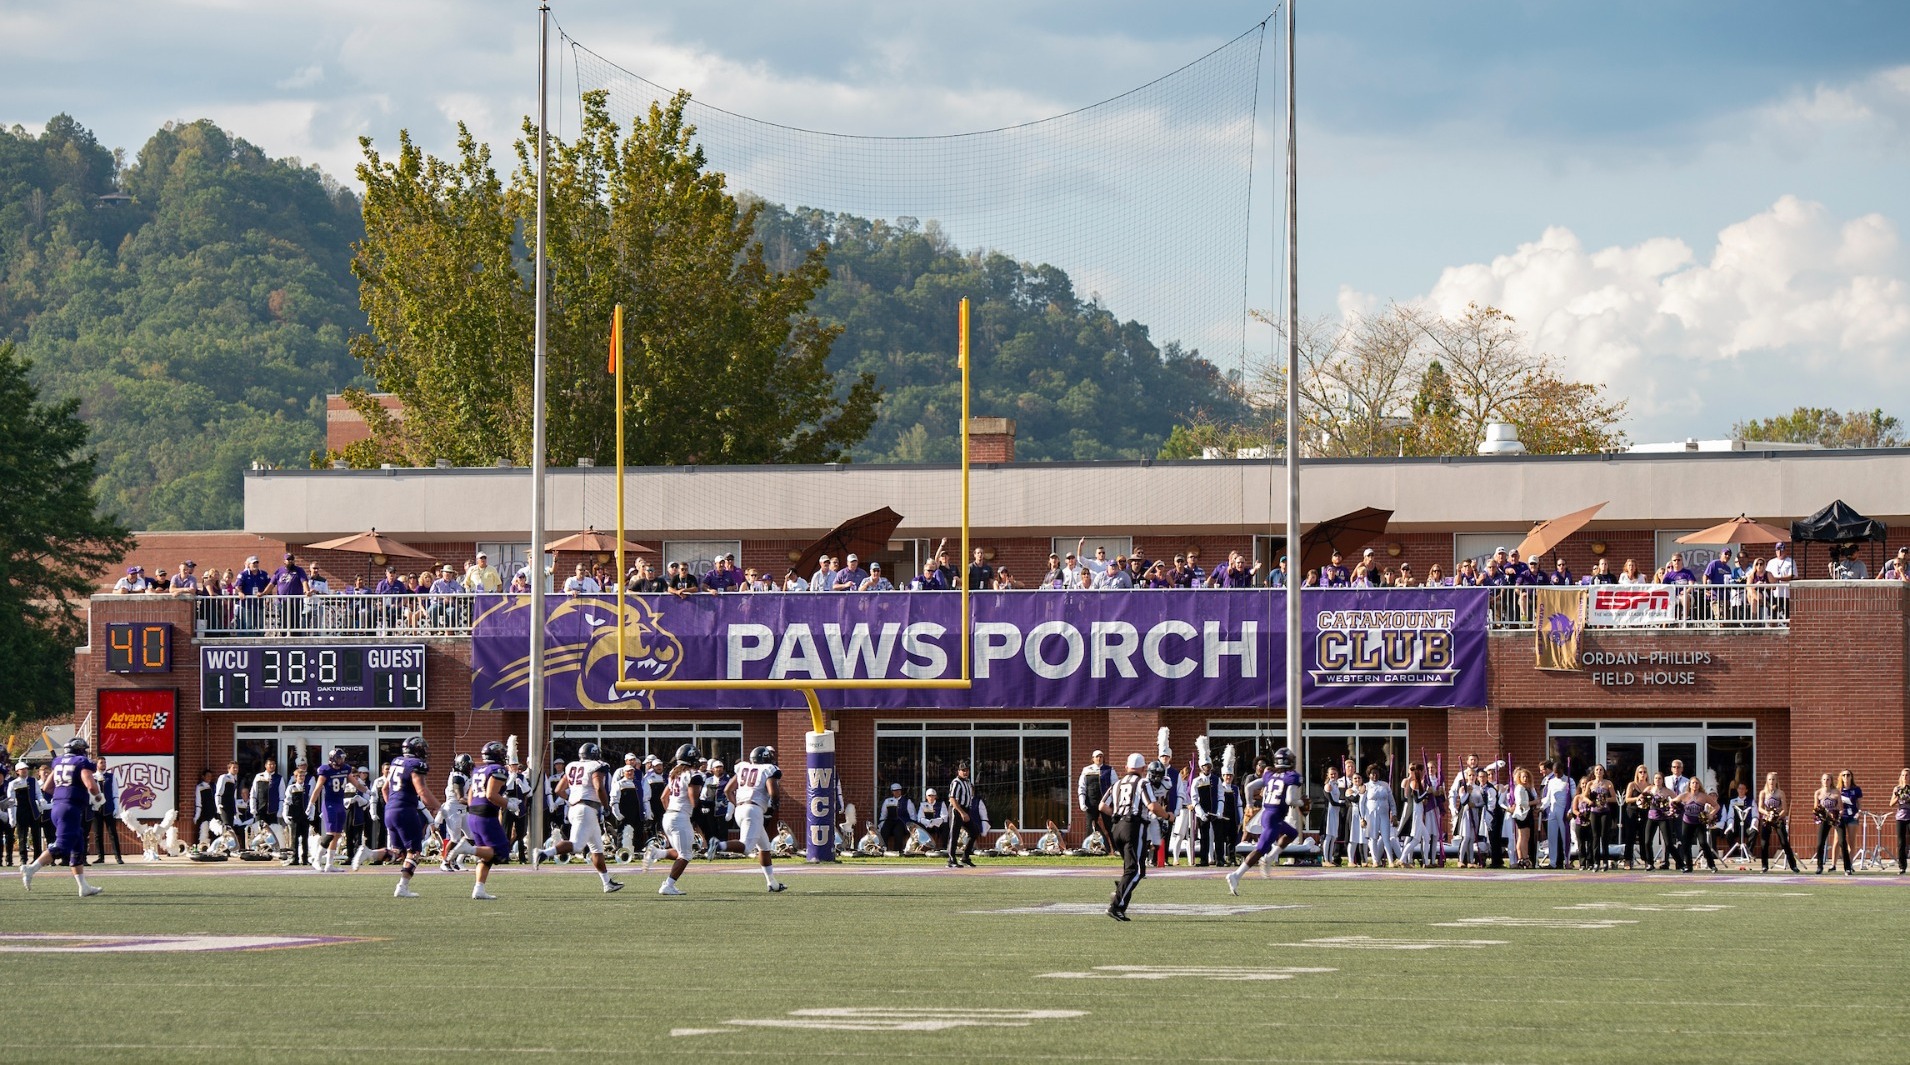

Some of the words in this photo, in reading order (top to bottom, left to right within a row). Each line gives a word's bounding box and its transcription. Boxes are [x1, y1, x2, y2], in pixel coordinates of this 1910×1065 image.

[1595, 591, 1670, 610] ESPN
[1319, 612, 1454, 629] CATAMOUNT
[111, 627, 165, 667] 40
[727, 623, 948, 680] PAWS
[974, 620, 1259, 679] PORCH
[1318, 630, 1453, 670] CLUB
[206, 650, 249, 669] WCU
[368, 649, 423, 668] GUEST
[1582, 651, 1711, 666] ORDAN-PHILLIPS
[1326, 674, 1380, 682] WESTERN
[1384, 674, 1442, 682] CAROLINA
[1592, 672, 1635, 685] FIELD
[1644, 672, 1695, 685] HOUSE
[219, 673, 249, 704] 17
[388, 673, 421, 703] 14
[281, 691, 311, 707] QTR
[105, 721, 127, 729] Auto
[127, 721, 150, 729] Parts
[110, 712, 152, 721] Advance
[332, 777, 348, 793] 84
[387, 765, 405, 792] 75
[568, 766, 585, 786] 92
[739, 767, 759, 788] 90
[1119, 783, 1133, 805] R
[1264, 778, 1284, 805] 12
[808, 768, 833, 846] WCU
